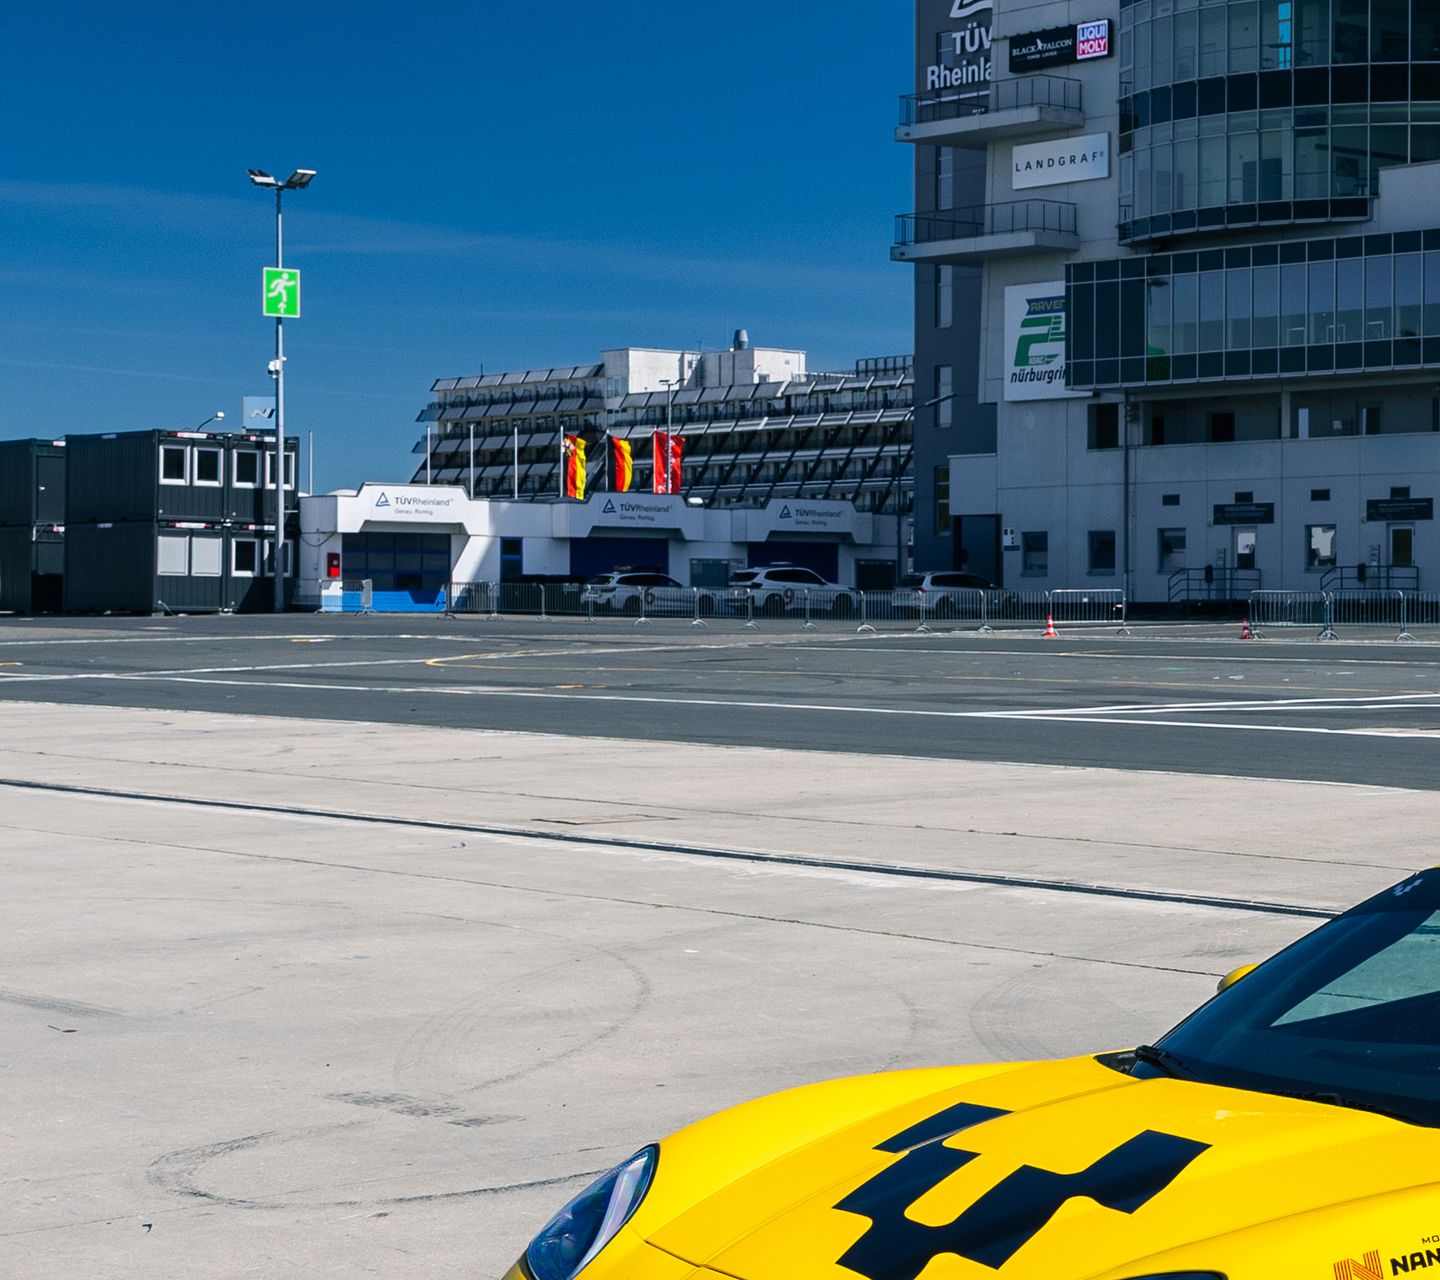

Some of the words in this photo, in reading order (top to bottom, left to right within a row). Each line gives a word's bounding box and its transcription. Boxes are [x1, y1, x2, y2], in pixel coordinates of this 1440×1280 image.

[1079, 24, 1106, 40] LIQUI
[1012, 44, 1038, 57] BLACK
[1041, 38, 1073, 51] FALCON
[1079, 39, 1106, 55] MOLY
[1015, 151, 1098, 172] LANDGRAF
[1010, 366, 1066, 384] nürburgri
